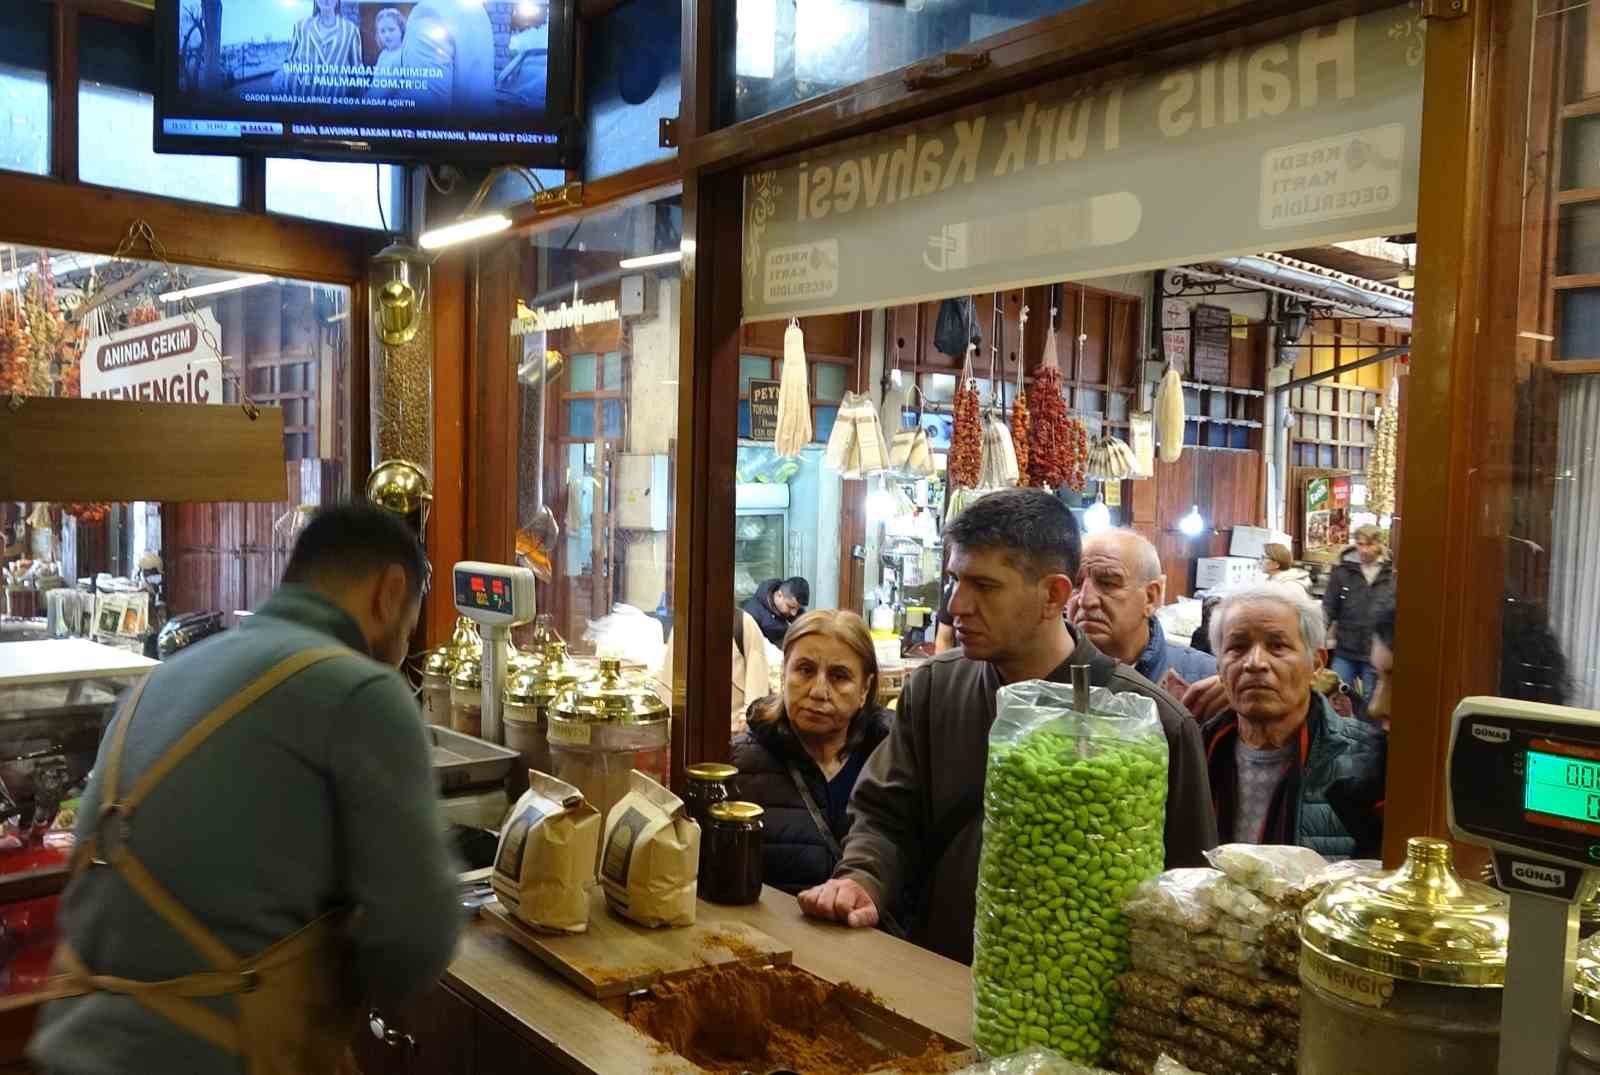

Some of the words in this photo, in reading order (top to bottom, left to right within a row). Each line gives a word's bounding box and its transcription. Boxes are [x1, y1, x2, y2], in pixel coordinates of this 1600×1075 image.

[104, 340, 149, 368] ANINDA
[151, 328, 191, 360] ÇEKİM
[1515, 867, 1562, 887] GÜNAŞ
